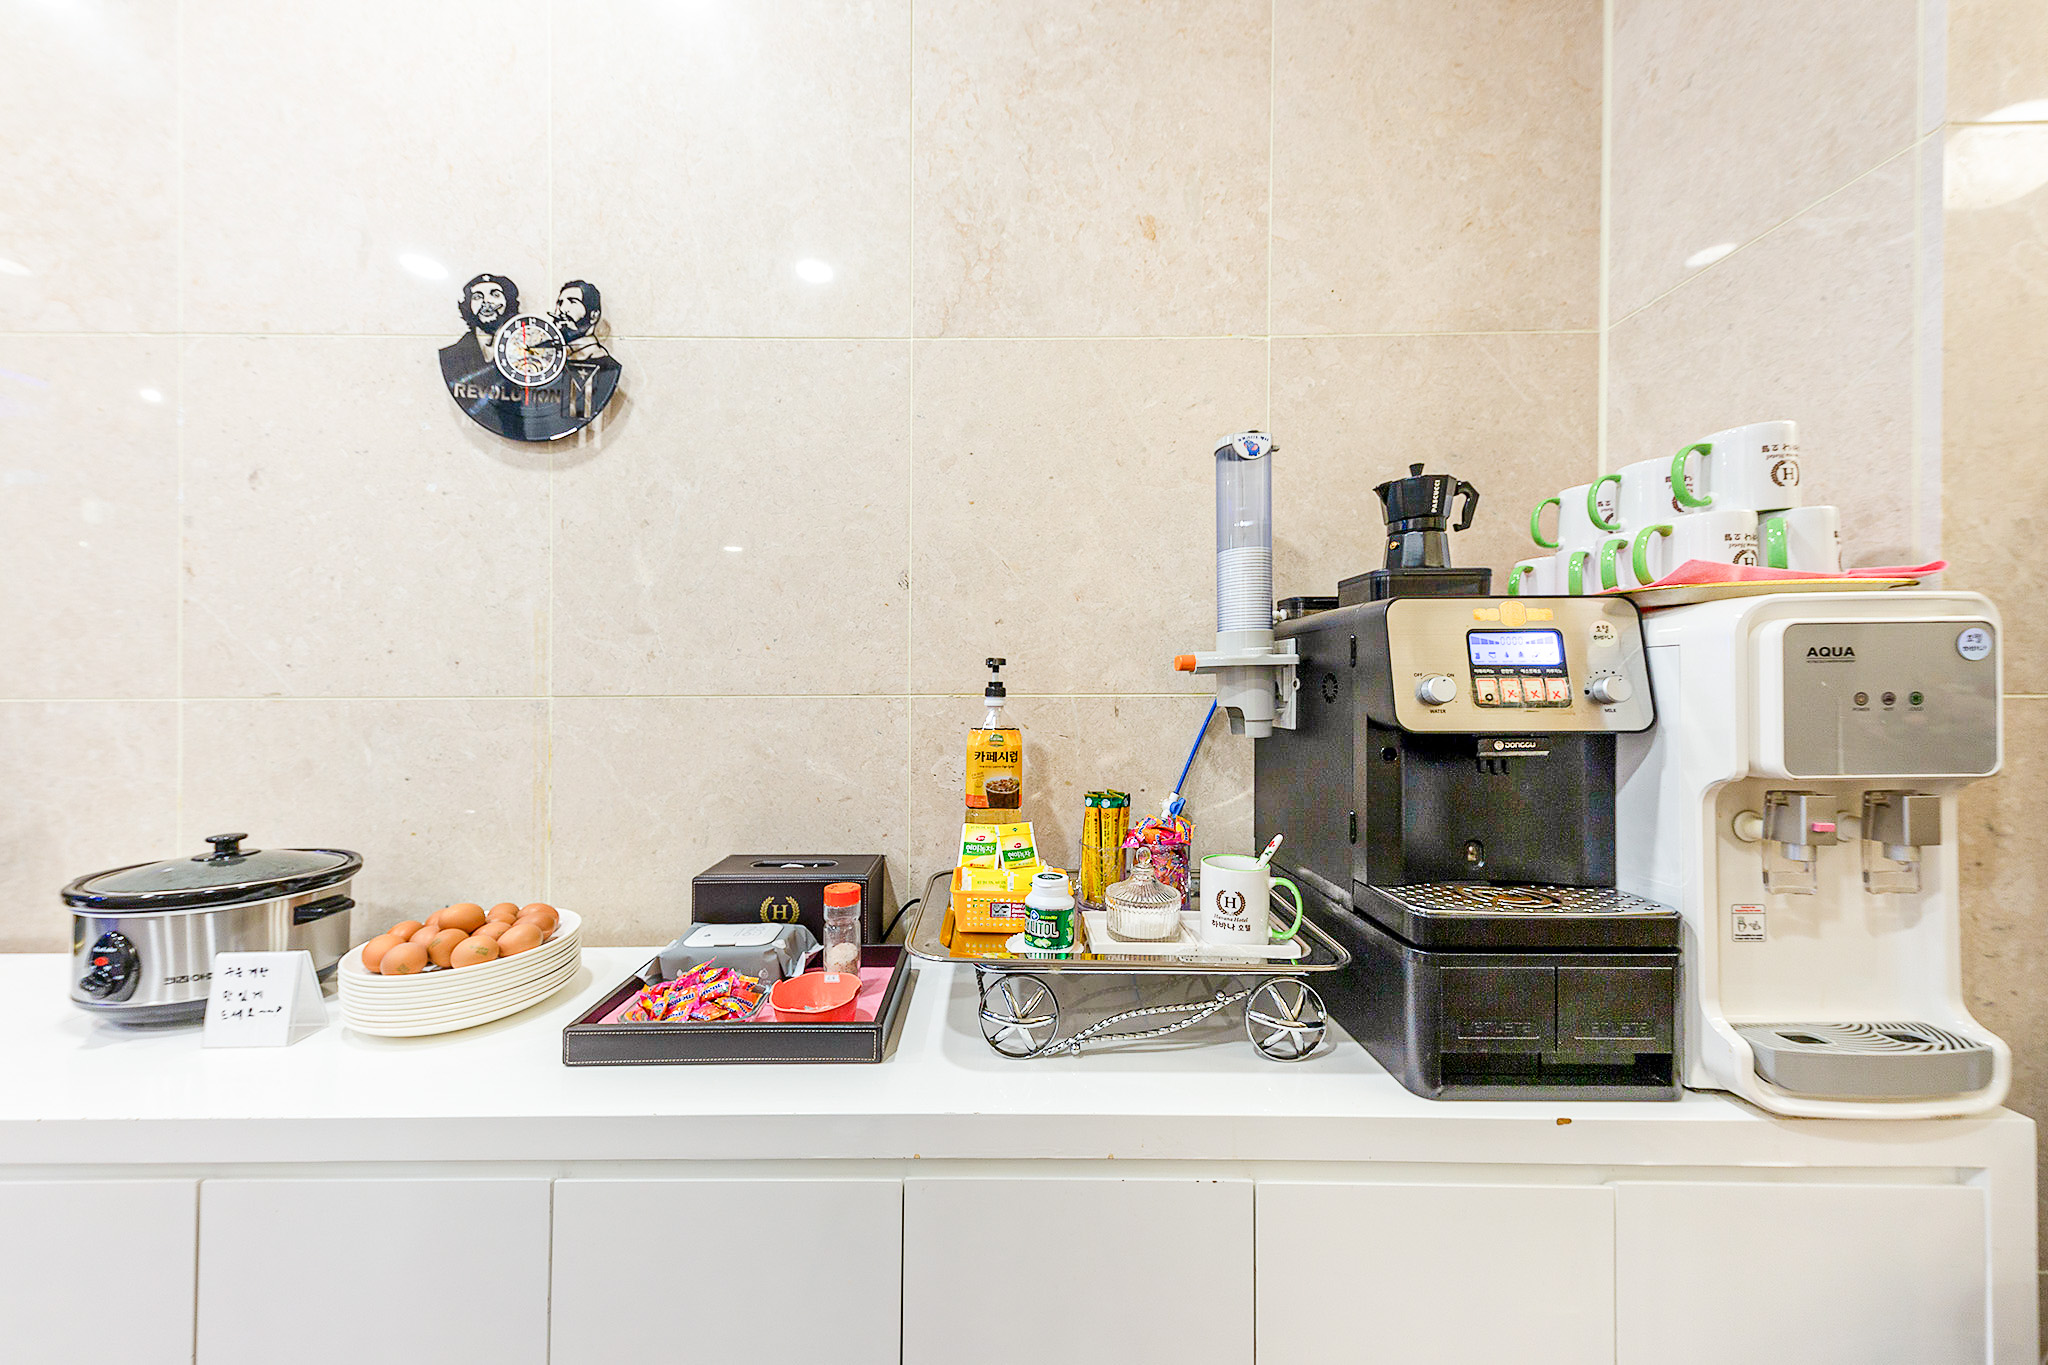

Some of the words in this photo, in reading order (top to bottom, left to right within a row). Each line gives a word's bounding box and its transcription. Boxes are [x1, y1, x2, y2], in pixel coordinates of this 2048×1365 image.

[1782, 467, 1795, 480] H
[1806, 646, 1856, 657] AQUA
[974, 750, 1018, 763] 카페시럽
[1224, 896, 1237, 909] H
[771, 904, 789, 920] H
